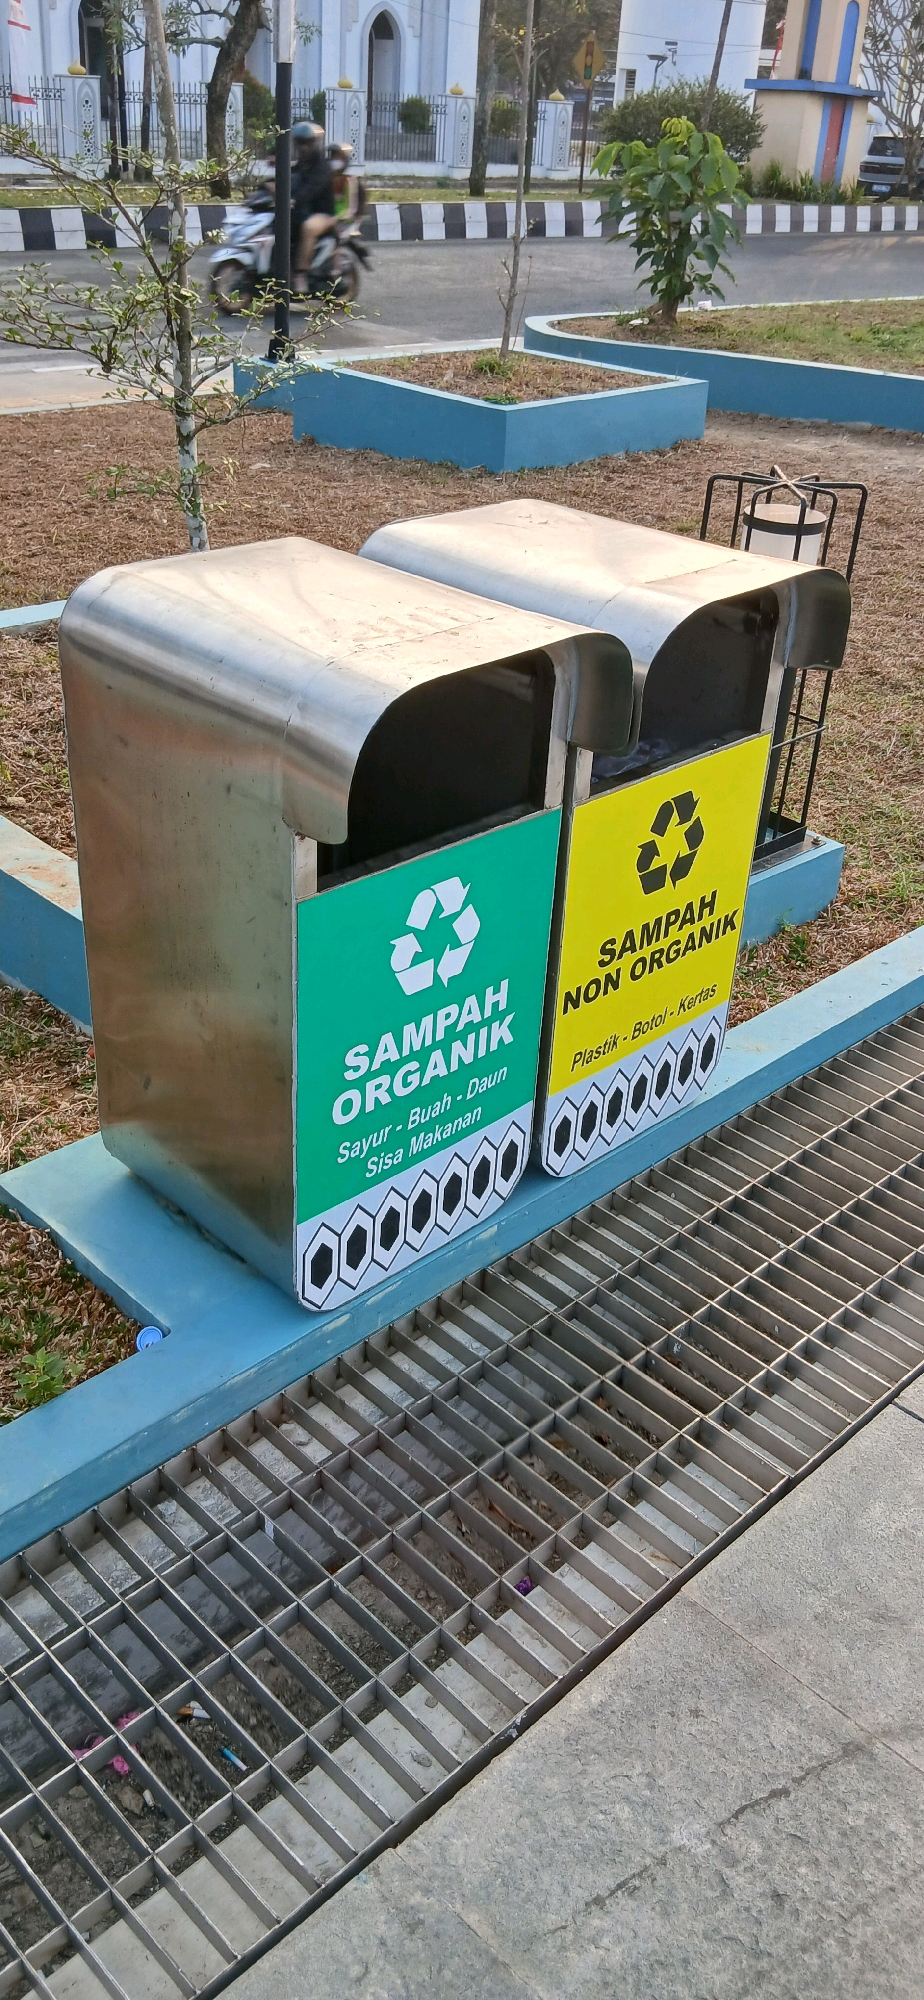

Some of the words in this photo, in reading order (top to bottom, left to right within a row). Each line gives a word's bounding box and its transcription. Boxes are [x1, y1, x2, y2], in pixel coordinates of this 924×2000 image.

[563, 968, 620, 1014] NON
[630, 909, 739, 981] ORGANIK
[597, 890, 717, 967] SAMPAH
[332, 1012, 515, 1125] ORGANIK
[343, 978, 509, 1081] SAMPAH
[571, 1034, 619, 1071] Plastik
[630, 1006, 668, 1041] Botol
[677, 984, 717, 1016] Kertas
[337, 1126, 392, 1164] Sayur
[407, 1093, 451, 1130] Buah
[466, 1066, 508, 1099] Daun
[365, 1153, 402, 1178] Sisa
[408, 1105, 482, 1158] Makanan
